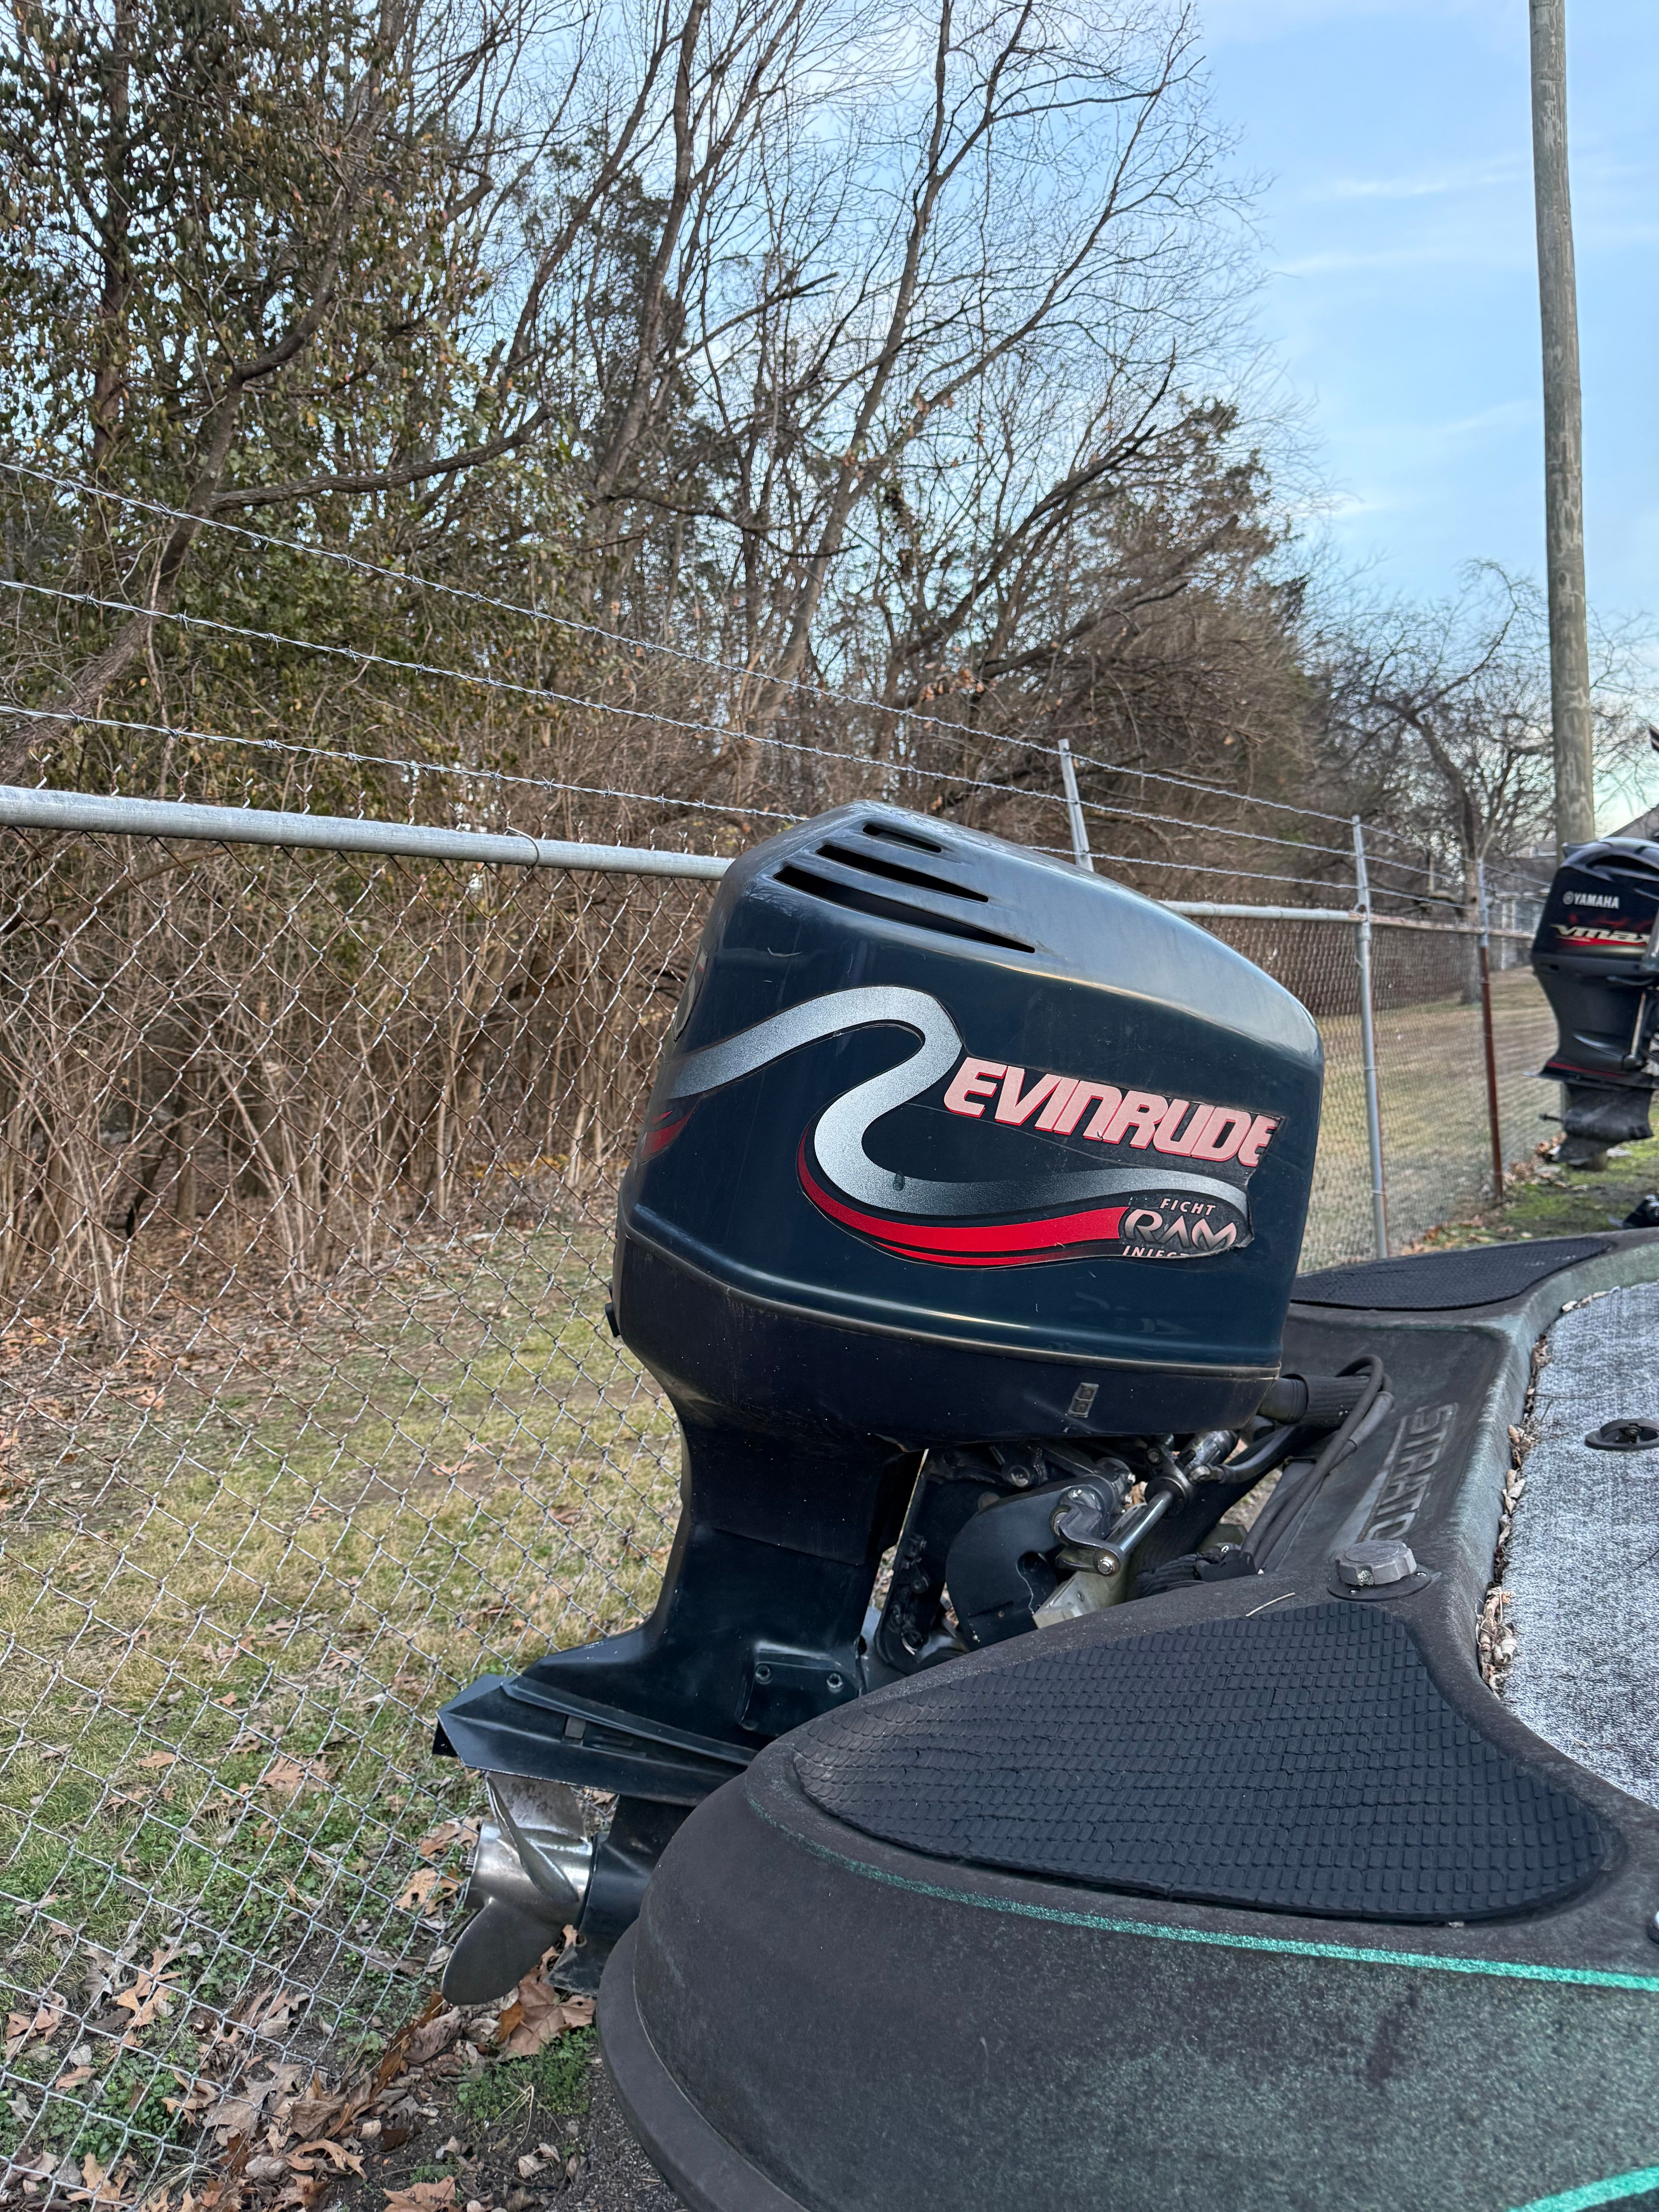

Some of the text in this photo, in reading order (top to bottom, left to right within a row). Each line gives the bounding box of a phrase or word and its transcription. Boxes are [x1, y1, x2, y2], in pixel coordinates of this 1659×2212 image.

[1574, 892, 1620, 909] YAMAHA
[944, 1057, 1281, 1167] EVINRUDE
[1160, 1198, 1216, 1216] FICHT
[1125, 1209, 1237, 1250] RAM
